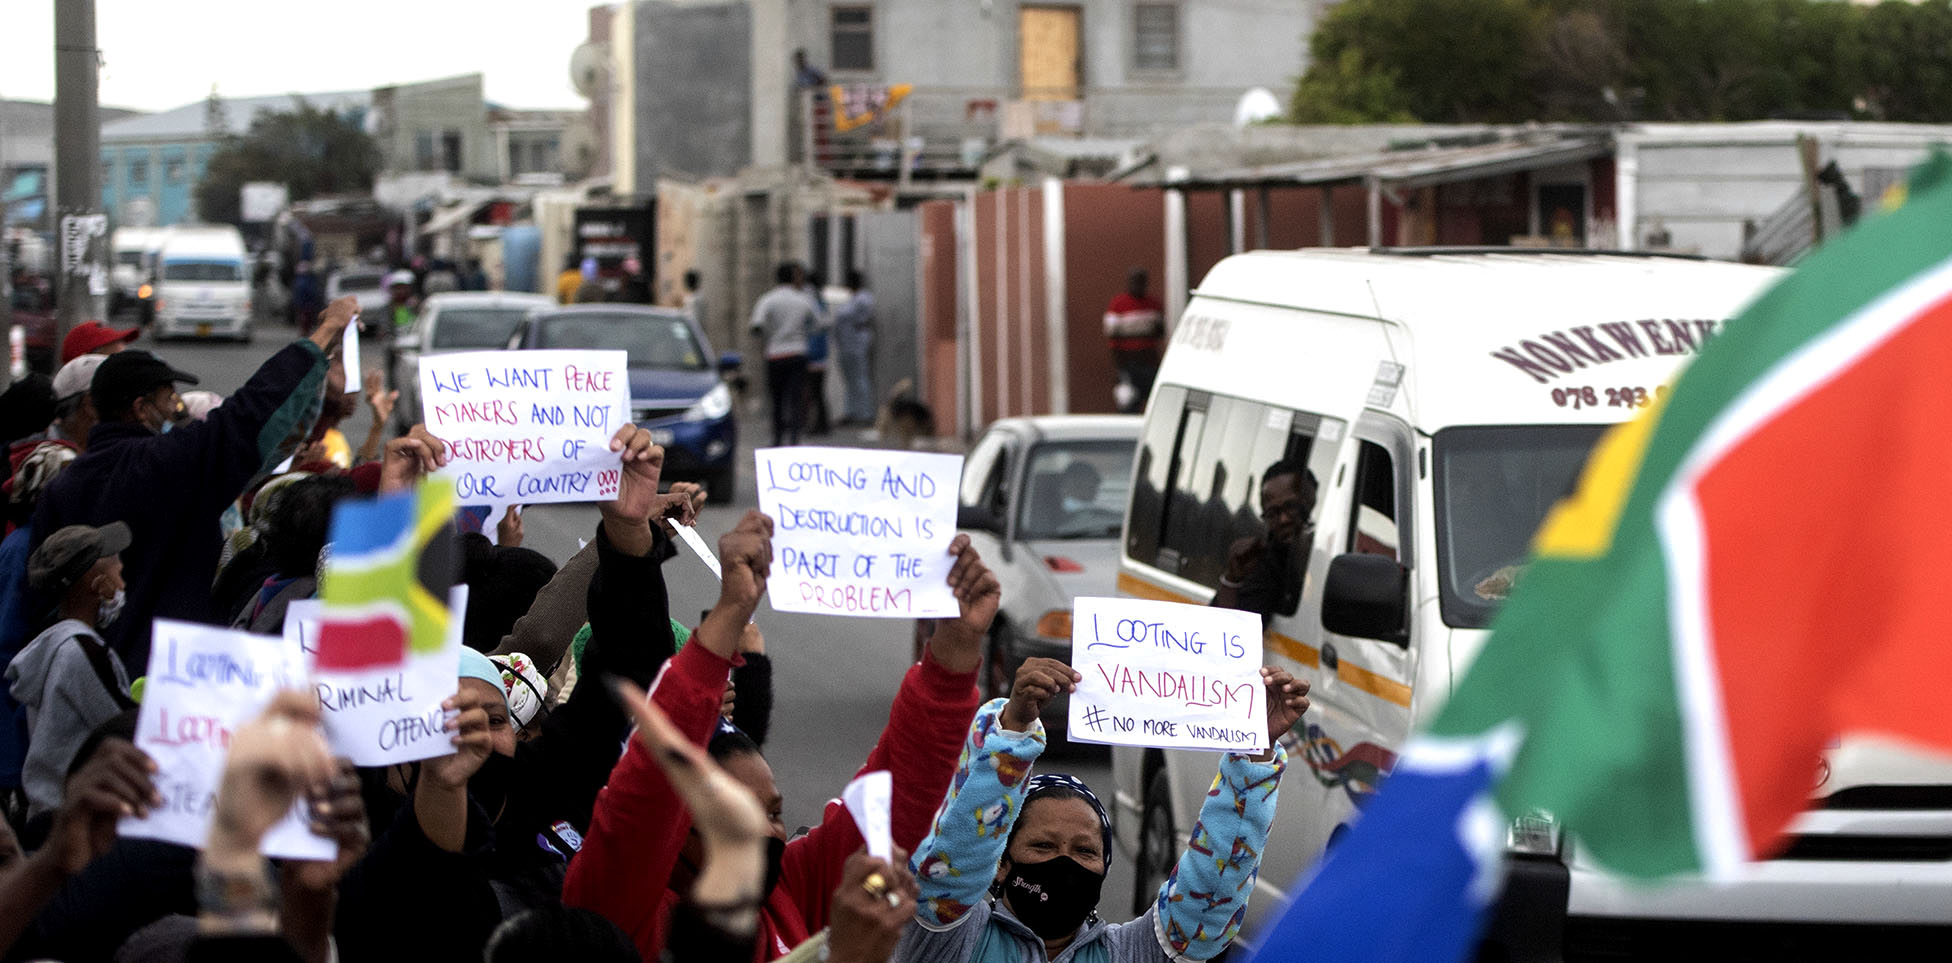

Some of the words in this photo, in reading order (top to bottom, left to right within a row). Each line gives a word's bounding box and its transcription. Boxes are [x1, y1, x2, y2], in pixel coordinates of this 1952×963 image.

[432, 369, 471, 393] WE
[485, 368, 552, 392] WANT
[565, 364, 614, 392] PEACE
[1551, 386, 1599, 410] 078
[1604, 386, 1652, 410] 293
[435, 400, 518, 426] MAKERS
[531, 403, 565, 426] AND
[573, 405, 611, 435] NOT
[442, 437, 545, 464] DESTROYERS
[562, 439, 587, 461] OF
[456, 472, 504, 499] OUR
[517, 471, 593, 498] COUNTRY
[767, 459, 867, 492] LOOTING
[881, 466, 936, 499] AND
[778, 502, 902, 538] DESTRUCTION
[916, 516, 934, 539] IS
[782, 547, 839, 579] PART
[853, 554, 878, 579] OF
[890, 553, 923, 579] THE
[799, 581, 912, 613] PROBLEM
[1087, 613, 1208, 655] LOOTING
[1223, 631, 1245, 659] IS
[315, 672, 413, 712] RIMINAL
[1097, 662, 1254, 720] VANDALISM
[379, 708, 448, 752] OFFENC
[1143, 719, 1178, 738] MORE
[1186, 724, 1257, 746] VANDALISM
